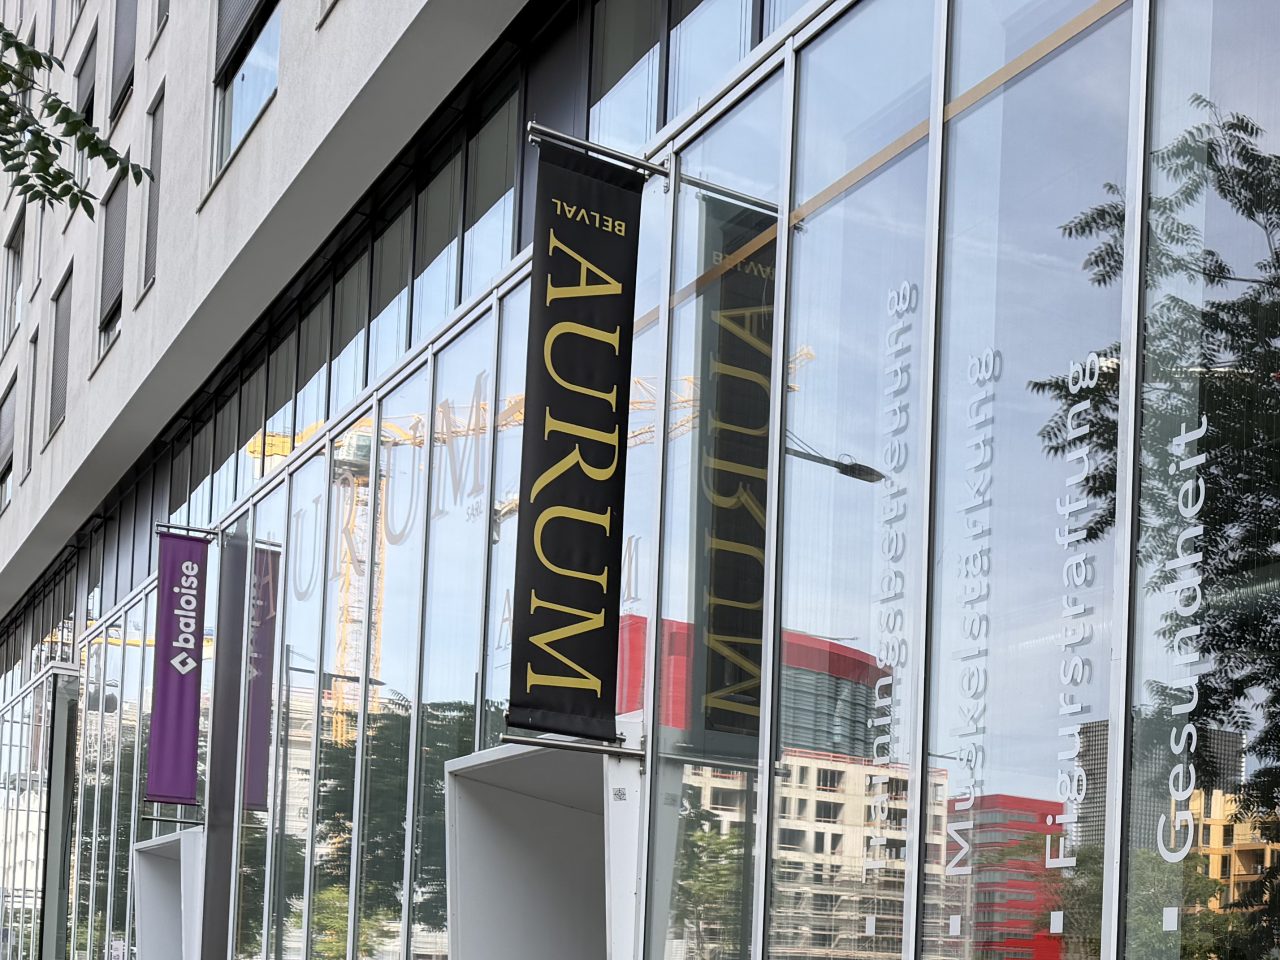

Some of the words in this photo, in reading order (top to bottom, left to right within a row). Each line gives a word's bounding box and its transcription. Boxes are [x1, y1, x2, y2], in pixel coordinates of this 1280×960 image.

[551, 198, 626, 237] BELVAL
[172, 560, 199, 649] baloise
[526, 228, 622, 698] AURUM
[945, 346, 998, 876] Muskelstärkung
[1045, 351, 1100, 868] Figurstraffung
[1156, 414, 1208, 863] Gesundheit
